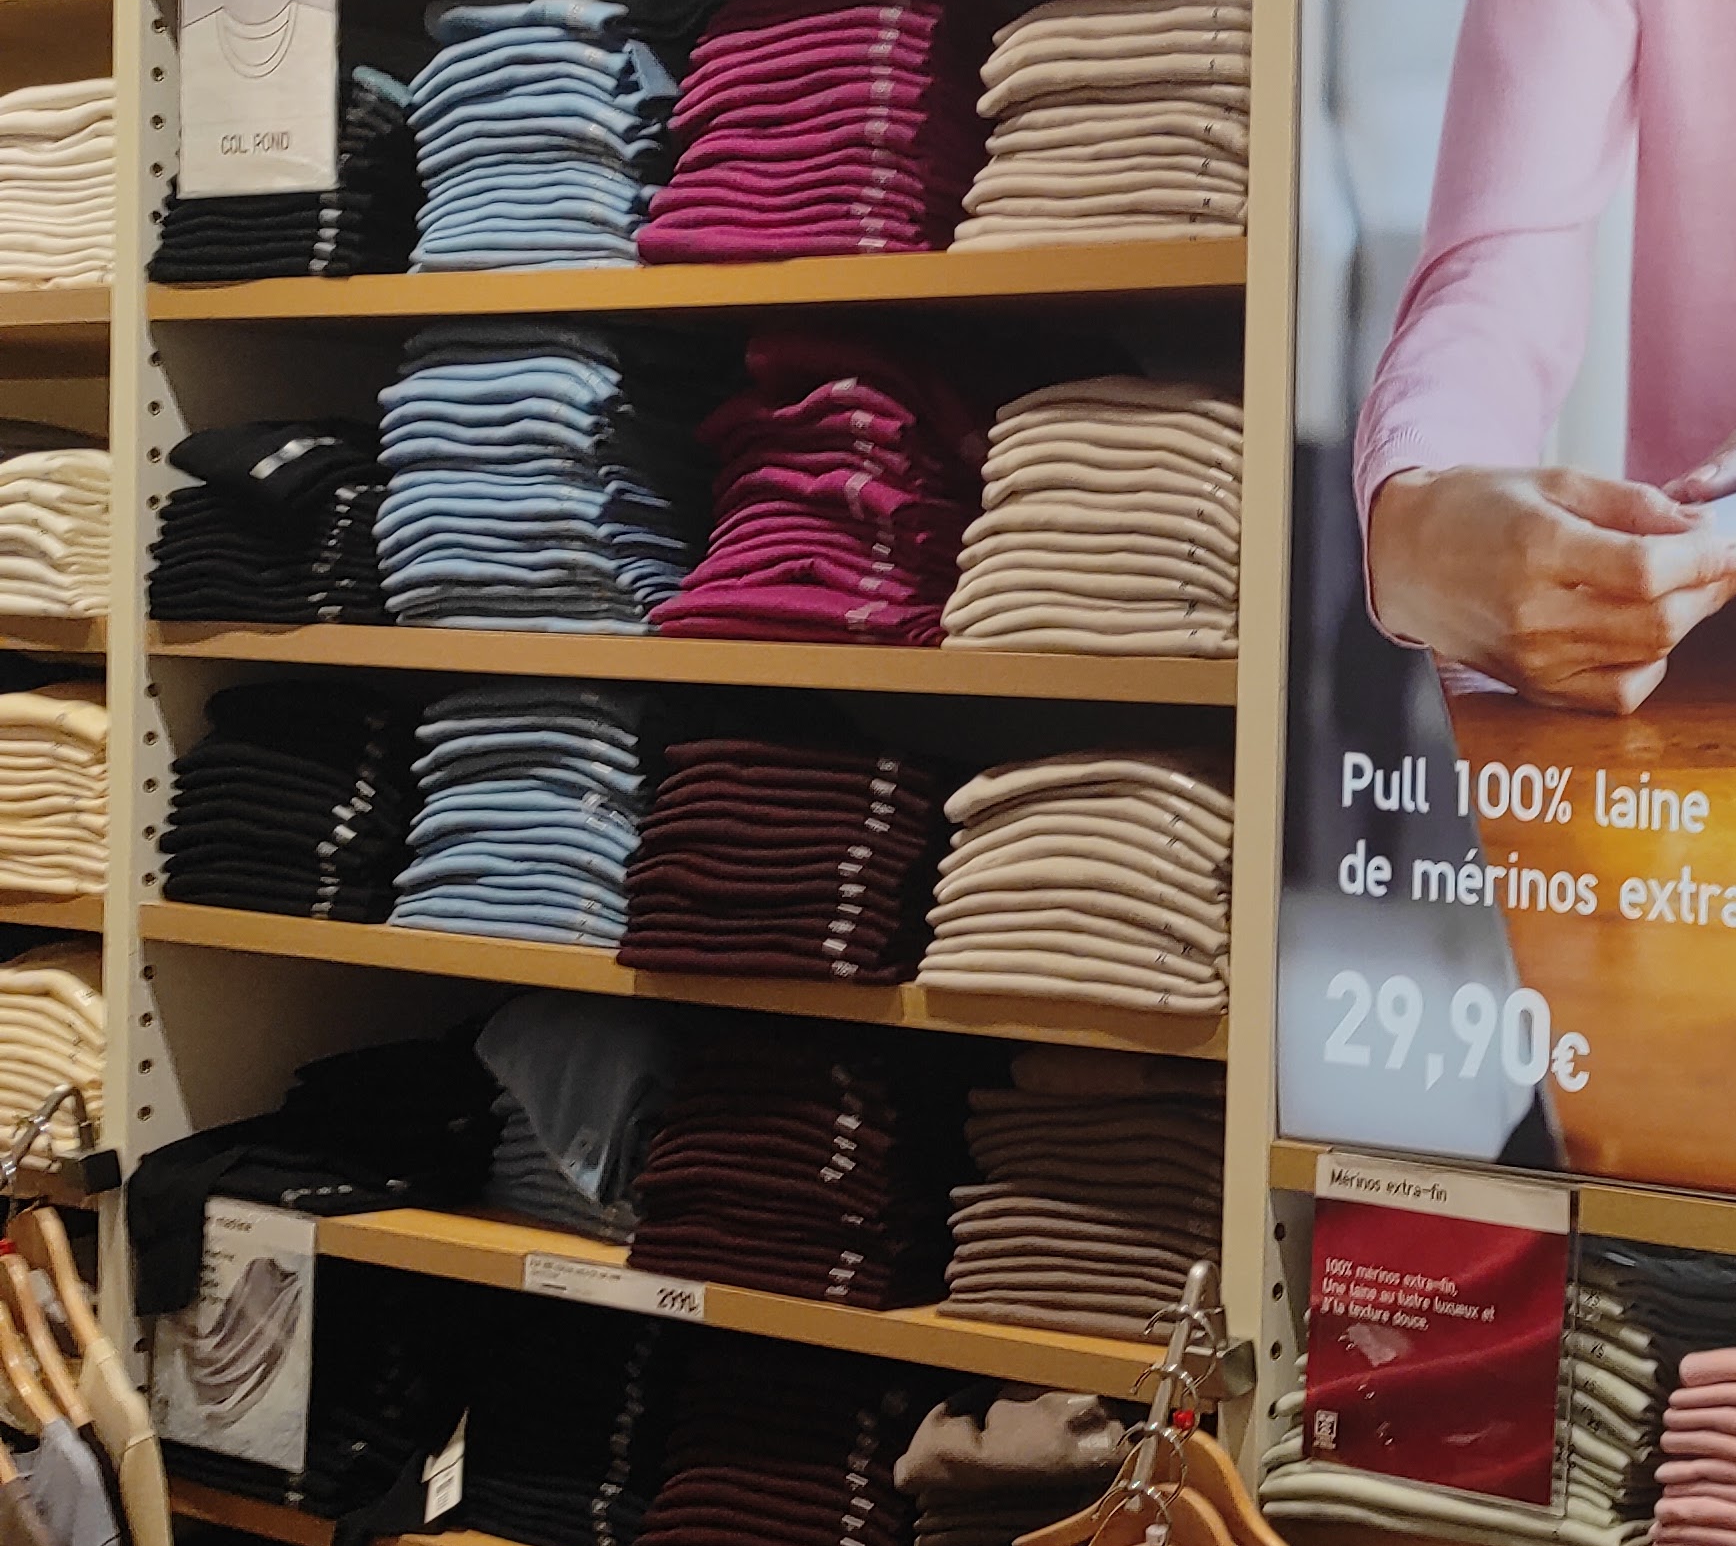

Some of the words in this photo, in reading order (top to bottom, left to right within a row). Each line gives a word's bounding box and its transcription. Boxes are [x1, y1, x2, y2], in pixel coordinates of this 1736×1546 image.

[1340, 751, 1431, 816] Pull
[1455, 758, 1574, 826] 100%
[1595, 768, 1711, 834] laine
[1339, 840, 1393, 897] de
[1411, 848, 1599, 917] mérinos
[1322, 969, 1591, 1094] 29,90€
[1330, 1168, 1381, 1193] Mérinos
[1386, 1179, 1448, 1202] extra-fin
